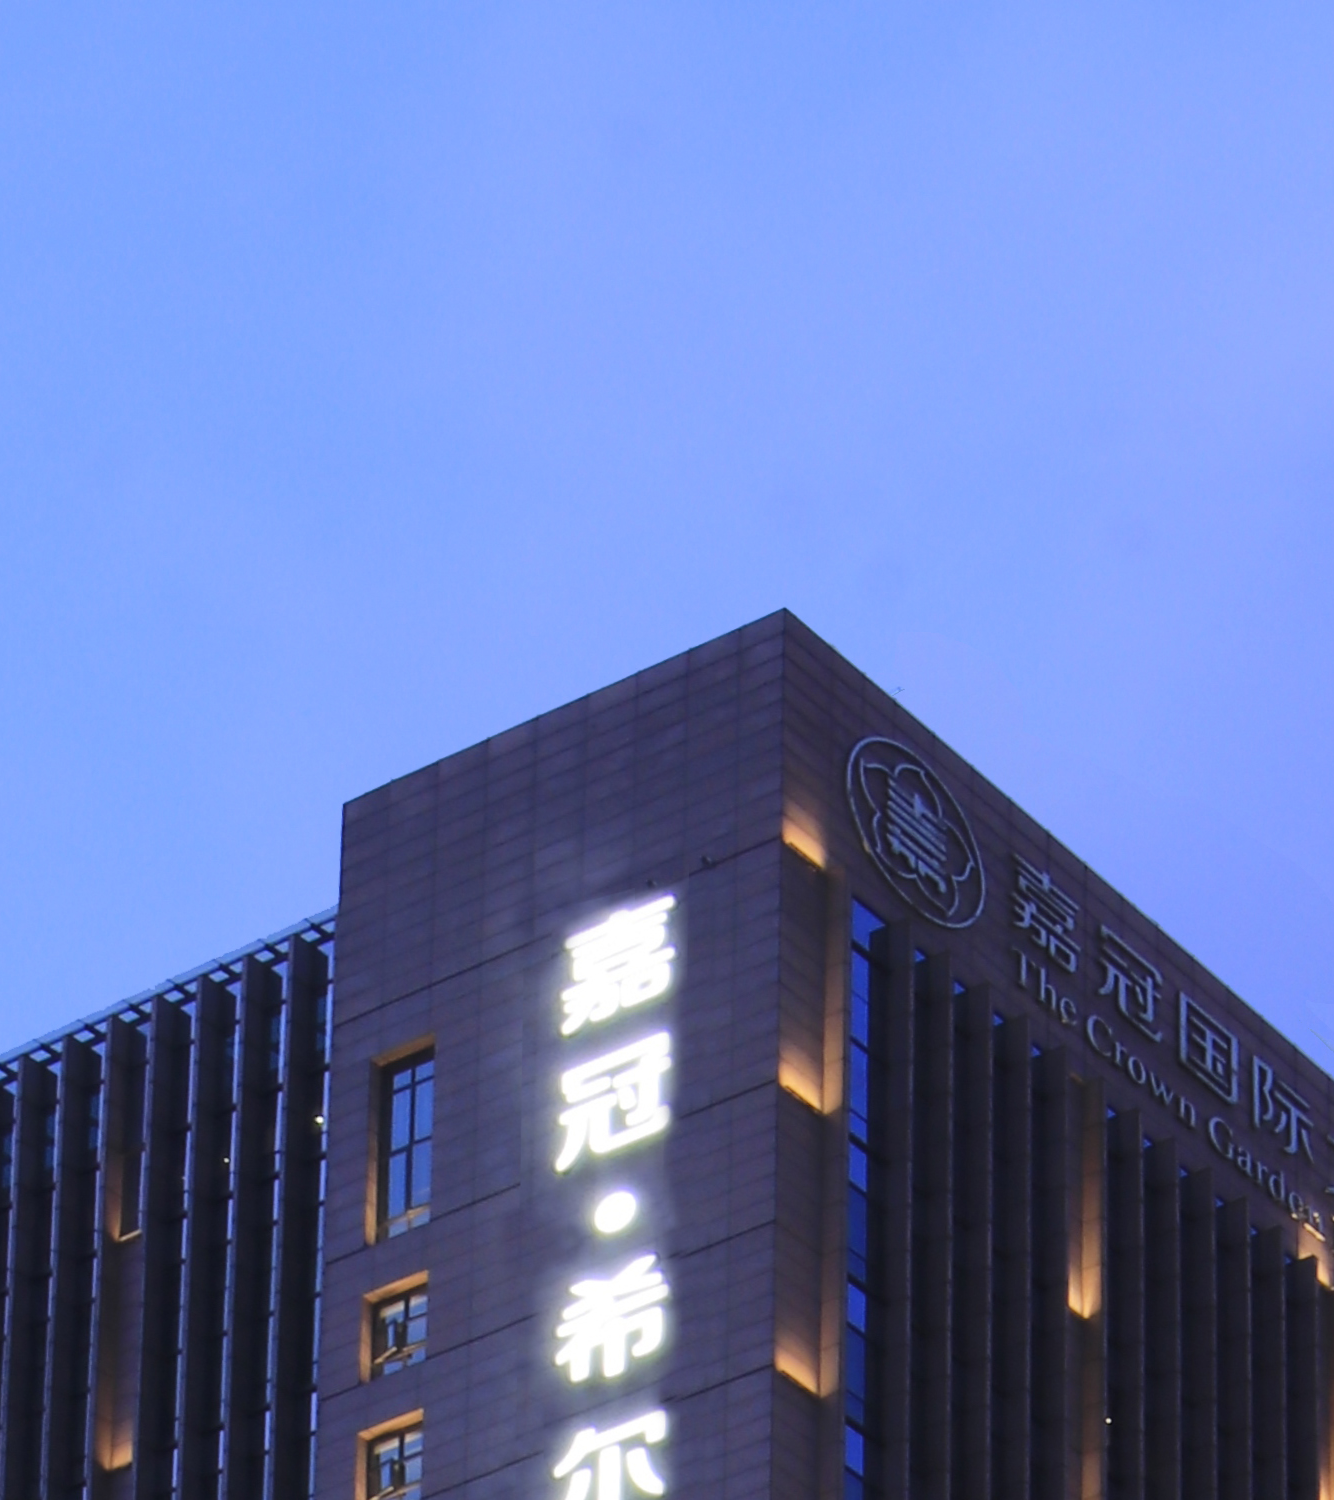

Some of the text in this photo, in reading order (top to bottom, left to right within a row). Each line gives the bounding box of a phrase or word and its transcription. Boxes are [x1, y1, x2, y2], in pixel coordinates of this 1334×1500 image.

[1011, 948, 1079, 1027] The
[1085, 1015, 1198, 1131] Crown
[1207, 1115, 1324, 1238] Garden
